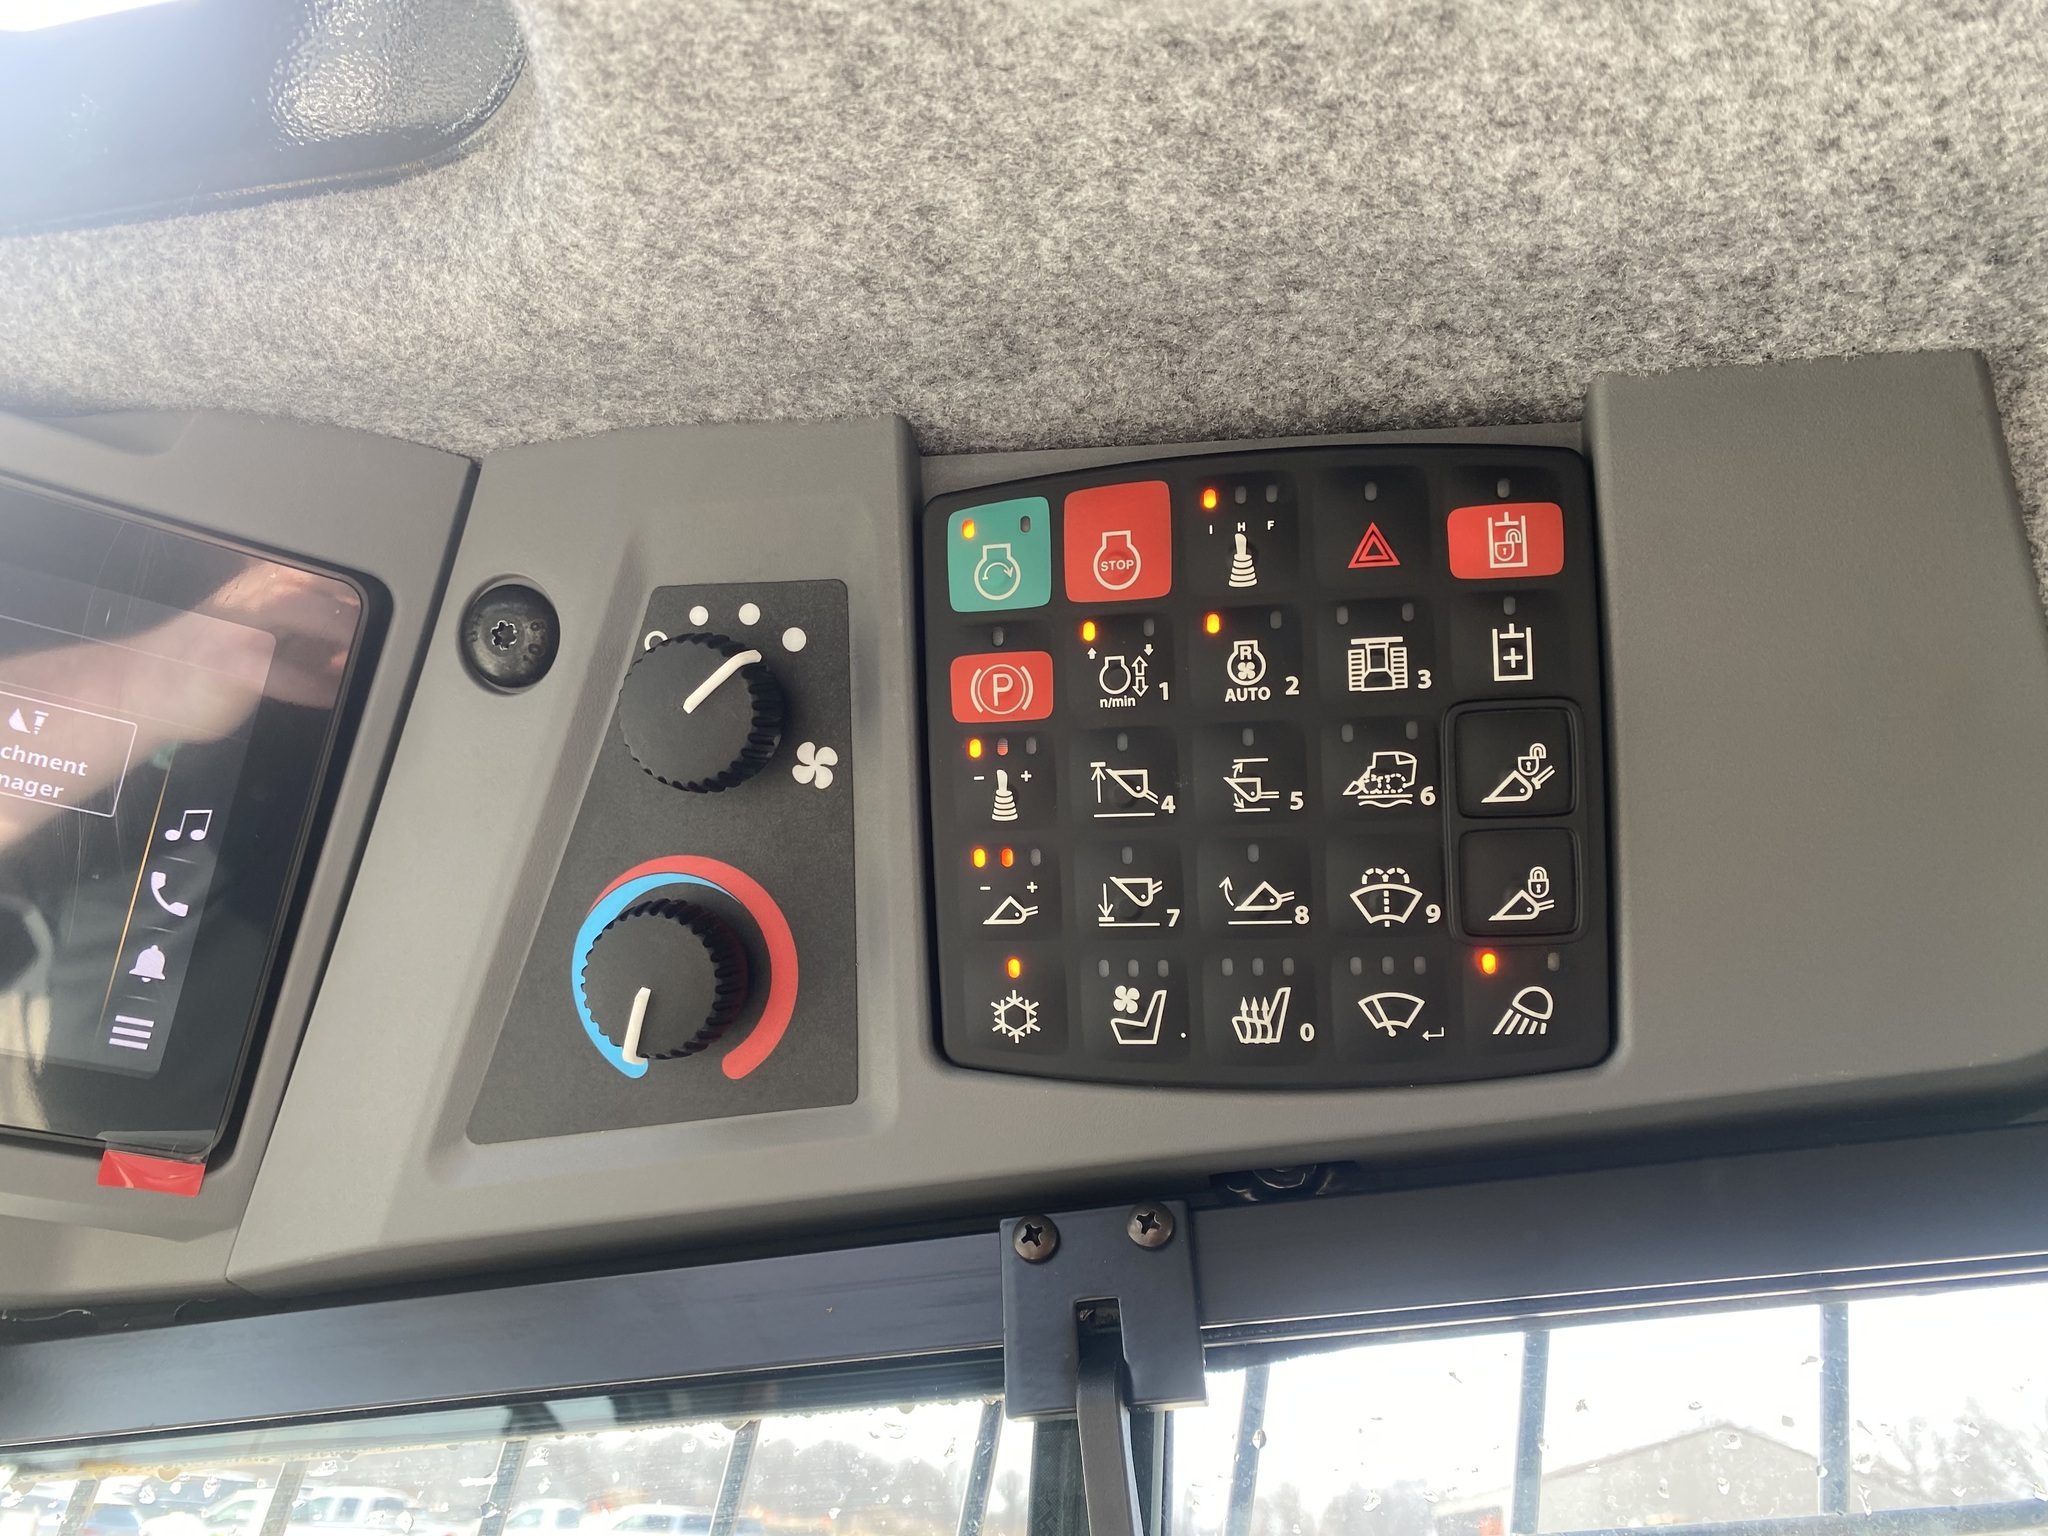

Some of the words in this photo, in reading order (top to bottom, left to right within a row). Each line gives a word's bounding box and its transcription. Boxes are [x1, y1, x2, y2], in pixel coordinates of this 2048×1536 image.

[1237, 521, 1247, 532] H
[1267, 520, 1276, 531] F
[1100, 559, 1135, 573] STOP
[1239, 645, 1253, 661] R
[1285, 675, 1300, 696] 2
[1417, 669, 1432, 690] 3
[992, 673, 1014, 707] P
[1158, 681, 1170, 701] 1
[1224, 686, 1272, 703] AUTO
[1099, 694, 1136, 709] n/min
[0, 744, 89, 777] chment
[1160, 795, 1176, 815] 4
[1289, 791, 1304, 811] 5
[1420, 786, 1436, 806] 6
[1166, 908, 1182, 928] 7
[1294, 905, 1310, 925] 8
[1425, 903, 1442, 924] 9
[1299, 1022, 1315, 1042] 0
